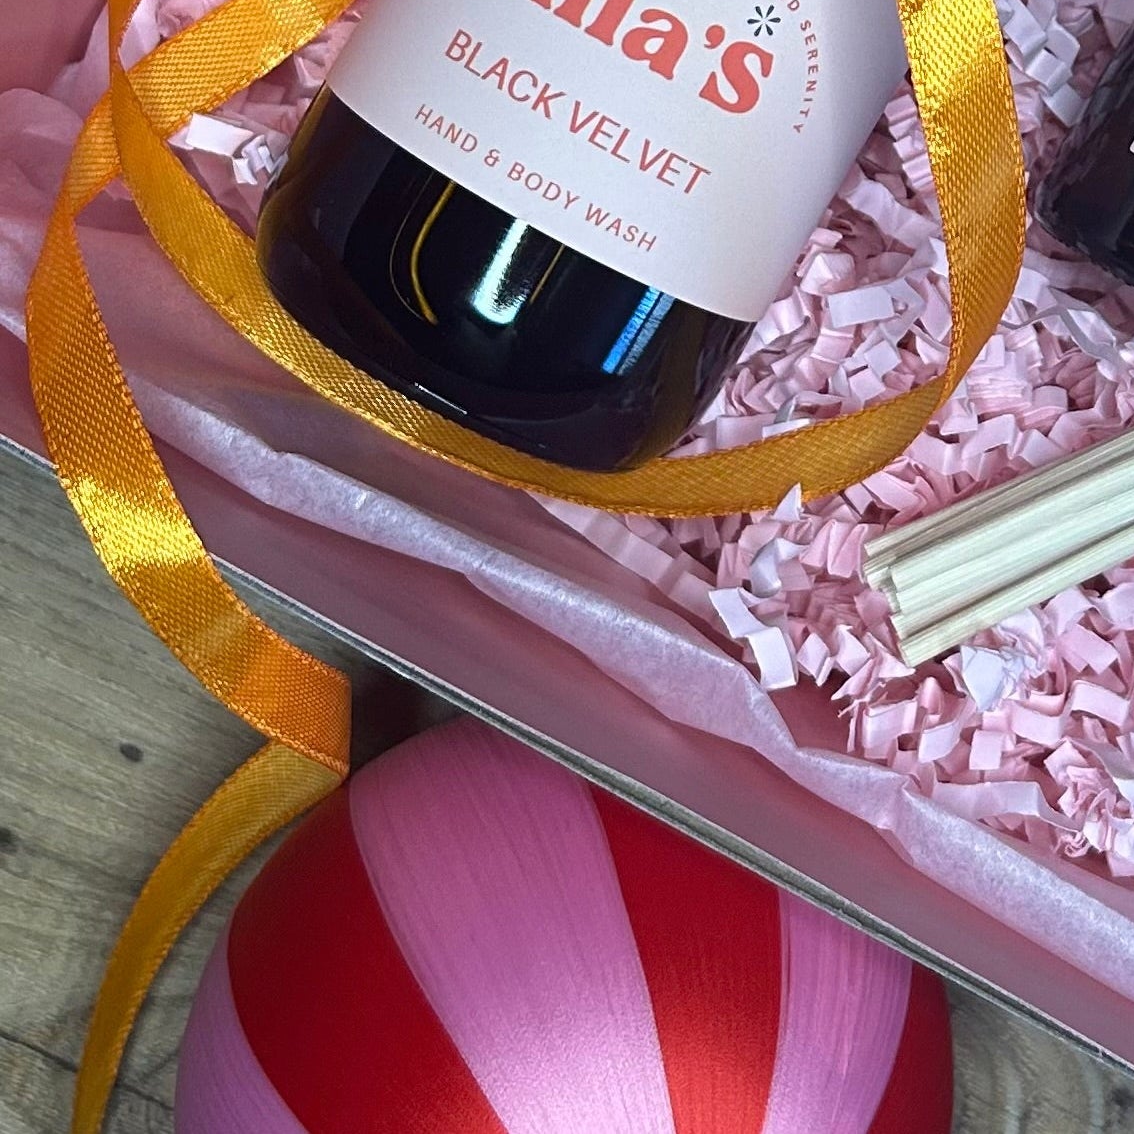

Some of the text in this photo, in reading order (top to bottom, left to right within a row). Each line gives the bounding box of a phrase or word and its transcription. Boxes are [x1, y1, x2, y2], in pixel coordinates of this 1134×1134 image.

[444, 29, 712, 195] BLACK VELVET
[793, 20, 822, 134] SERENITY
[414, 104, 658, 253] HAND & BODY WASH
